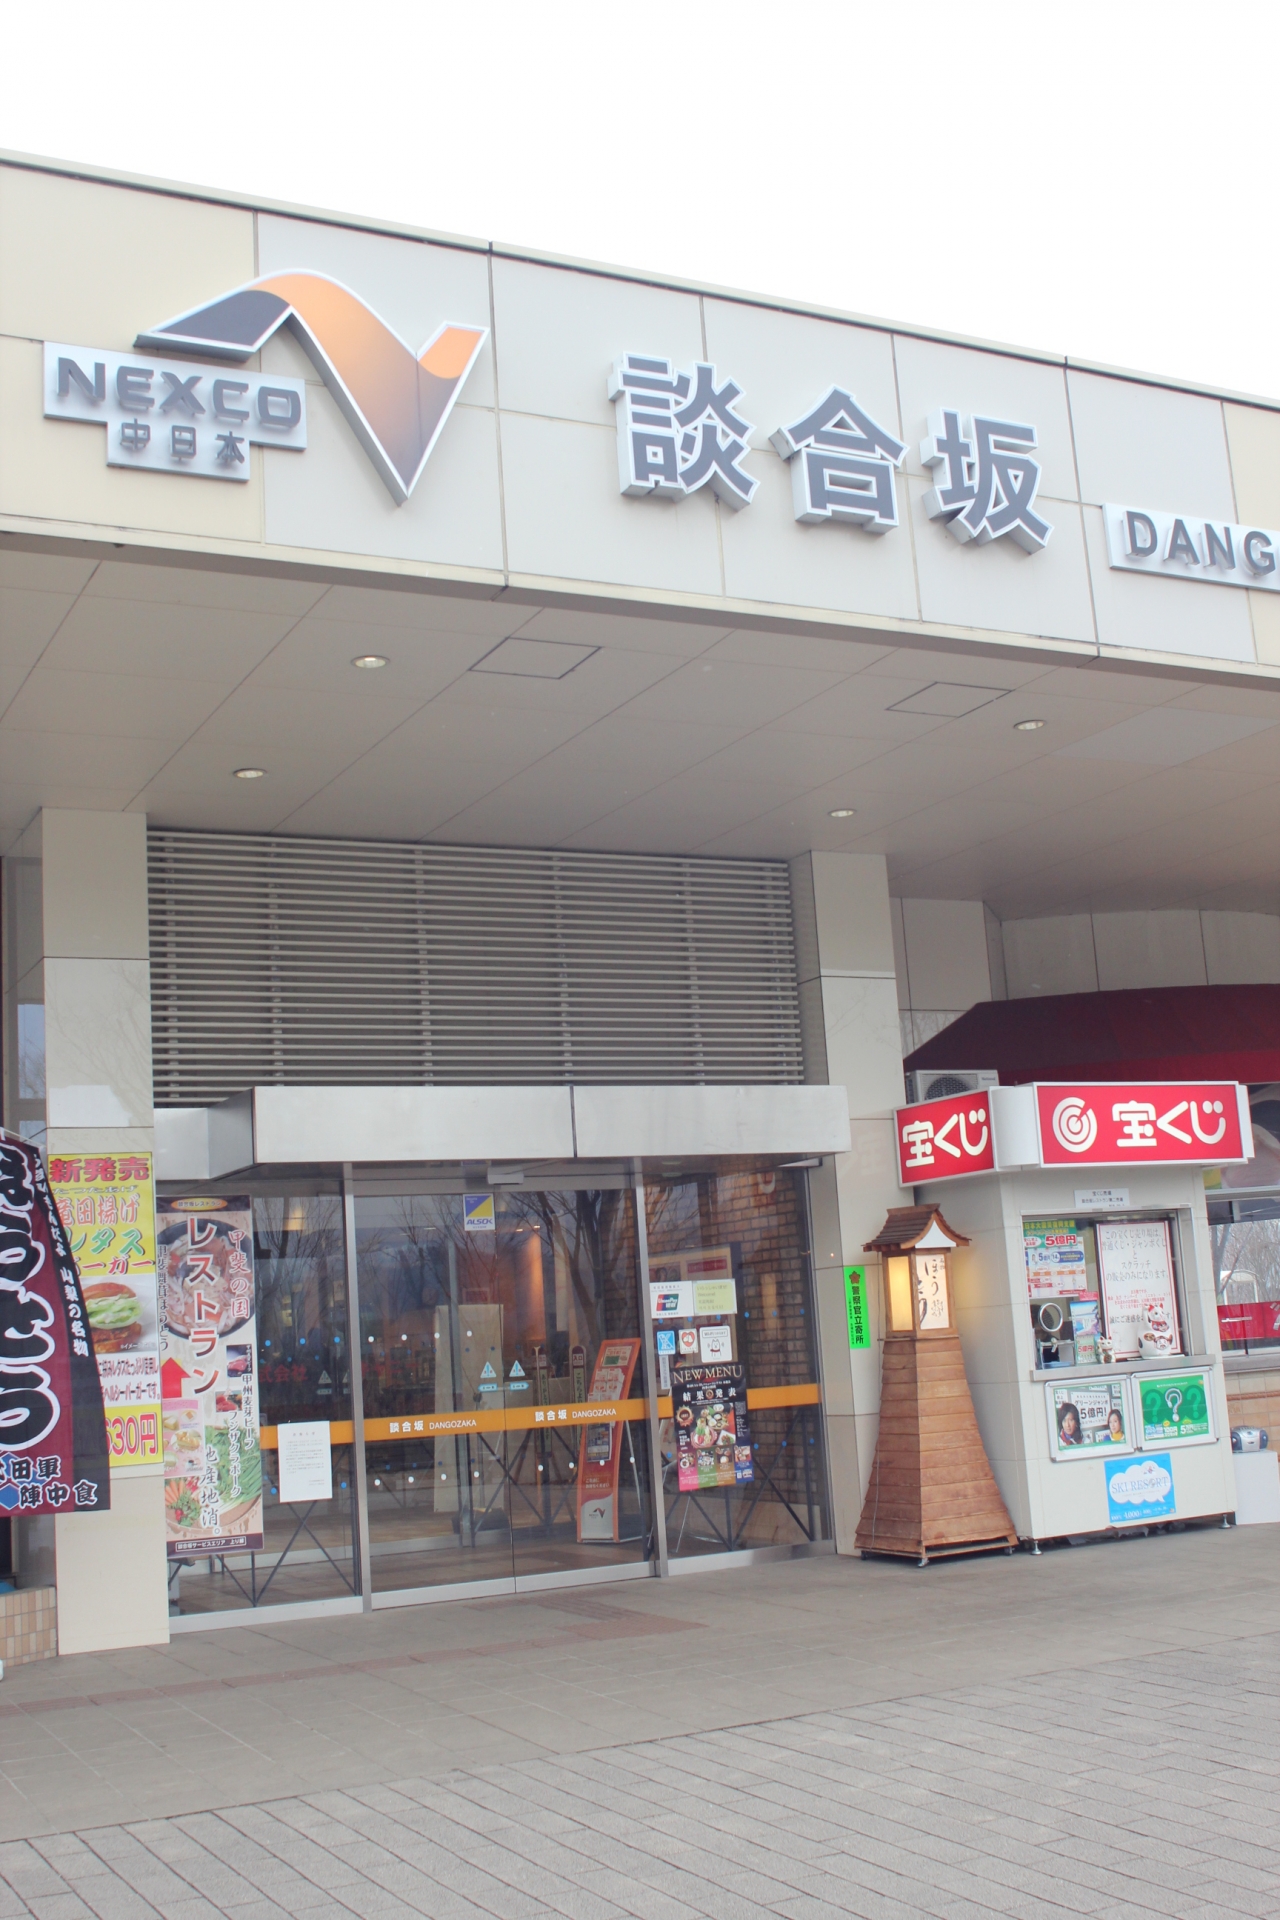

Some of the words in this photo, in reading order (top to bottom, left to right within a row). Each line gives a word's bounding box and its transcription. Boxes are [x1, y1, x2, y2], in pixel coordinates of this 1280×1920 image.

[56, 357, 302, 430] NEXCO
[119, 418, 246, 464] 中日本
[608, 352, 1053, 554] 談合坂
[902, 1108, 988, 1168] 宝くじ
[1112, 1100, 1226, 1148] 宝くじ
[49, 1156, 150, 1183] 新発売
[1045, 1234, 1077, 1247] 5億円
[228, 1229, 251, 1319] 甲斐の国
[60, 1266, 90, 1358] 山梨の名物
[187, 1216, 219, 1395] レストラン
[851, 1285, 864, 1345] 警察官立寄所
[673, 1368, 703, 1384] NEW
[705, 1364, 743, 1379] MENU
[389, 1420, 424, 1433] 談合坂
[429, 1418, 477, 1430] DANGOZAKA
[534, 1409, 568, 1422] 談合坂
[571, 1408, 617, 1419] DANGOZAKA
[1080, 1407, 1107, 1419] 5億円!
[18, 1479, 98, 1509] 陣中食
[1111, 1482, 1128, 1494] SKI
[1130, 1476, 1168, 1491] RESORT
